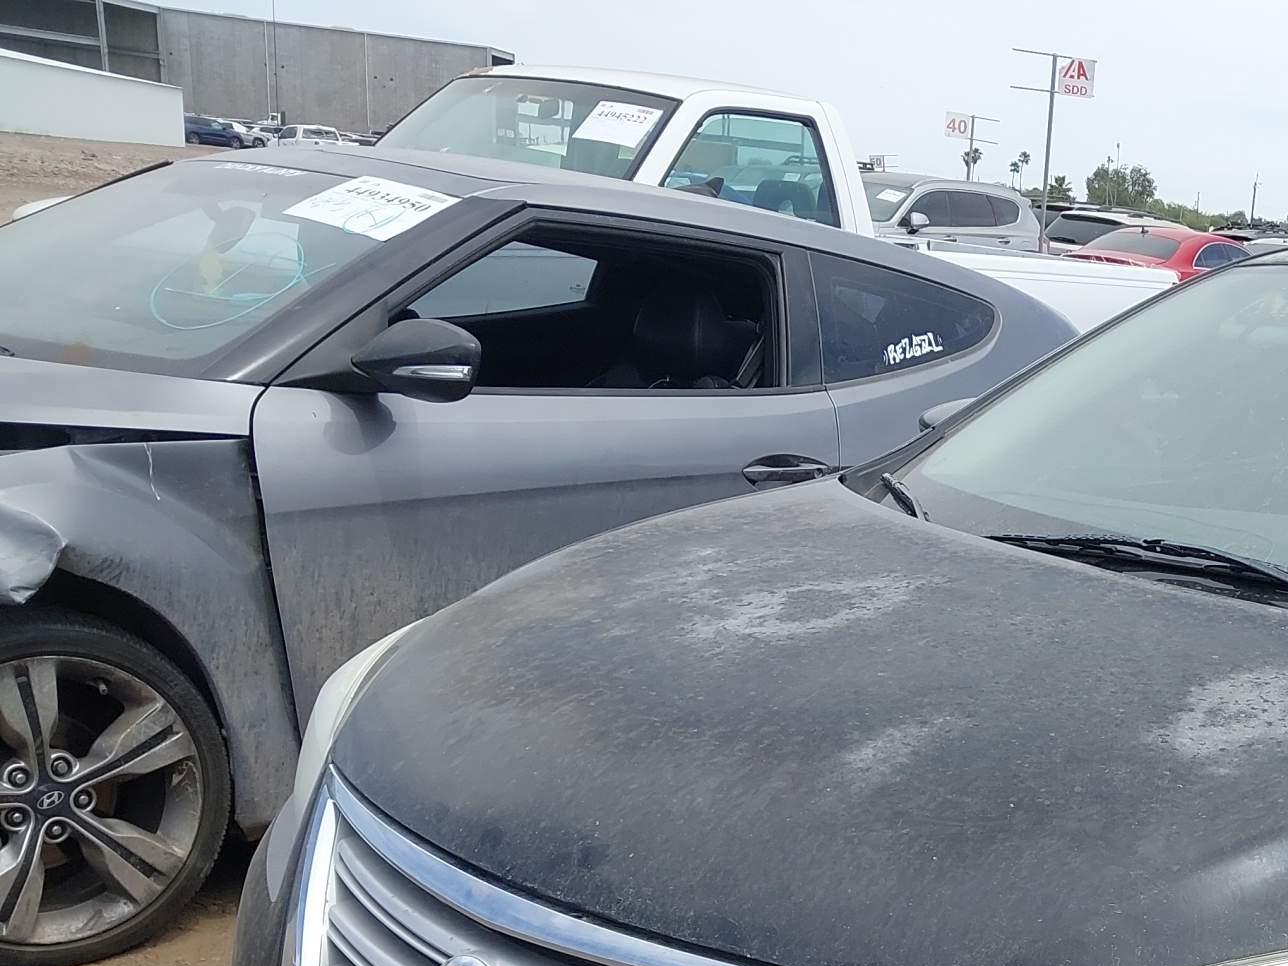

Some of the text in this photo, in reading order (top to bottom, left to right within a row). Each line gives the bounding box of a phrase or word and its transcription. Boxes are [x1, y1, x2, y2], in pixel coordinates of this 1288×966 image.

[1063, 84, 1088, 96] SDD
[597, 110, 648, 124] 44945222
[946, 118, 968, 134] 40
[344, 186, 432, 212] 44934950
